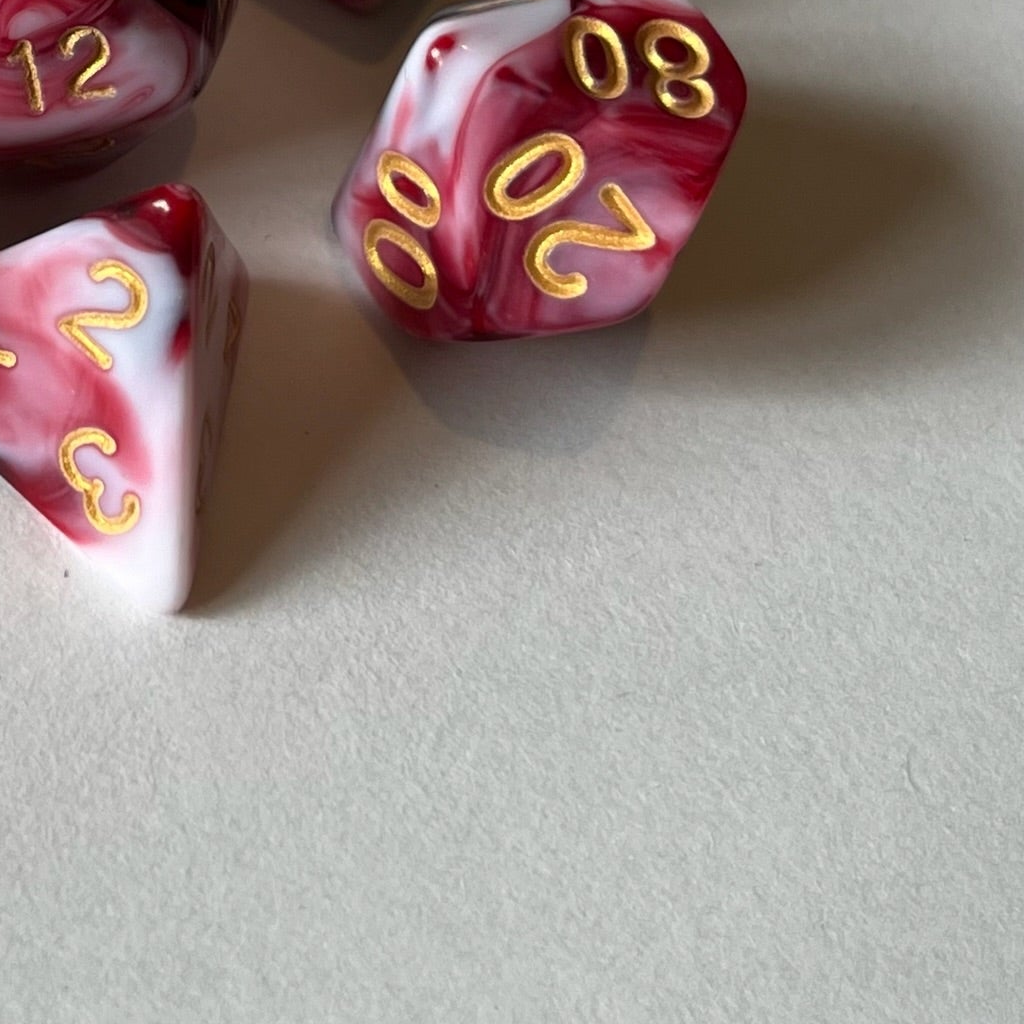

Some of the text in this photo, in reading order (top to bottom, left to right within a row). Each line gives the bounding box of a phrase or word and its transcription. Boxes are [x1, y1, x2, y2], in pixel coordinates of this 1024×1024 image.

[7, 25, 117, 116] 12
[364, 150, 441, 310] 00
[483, 131, 656, 300] 20
[57, 258, 150, 371] 2
[58, 426, 142, 537] 3
